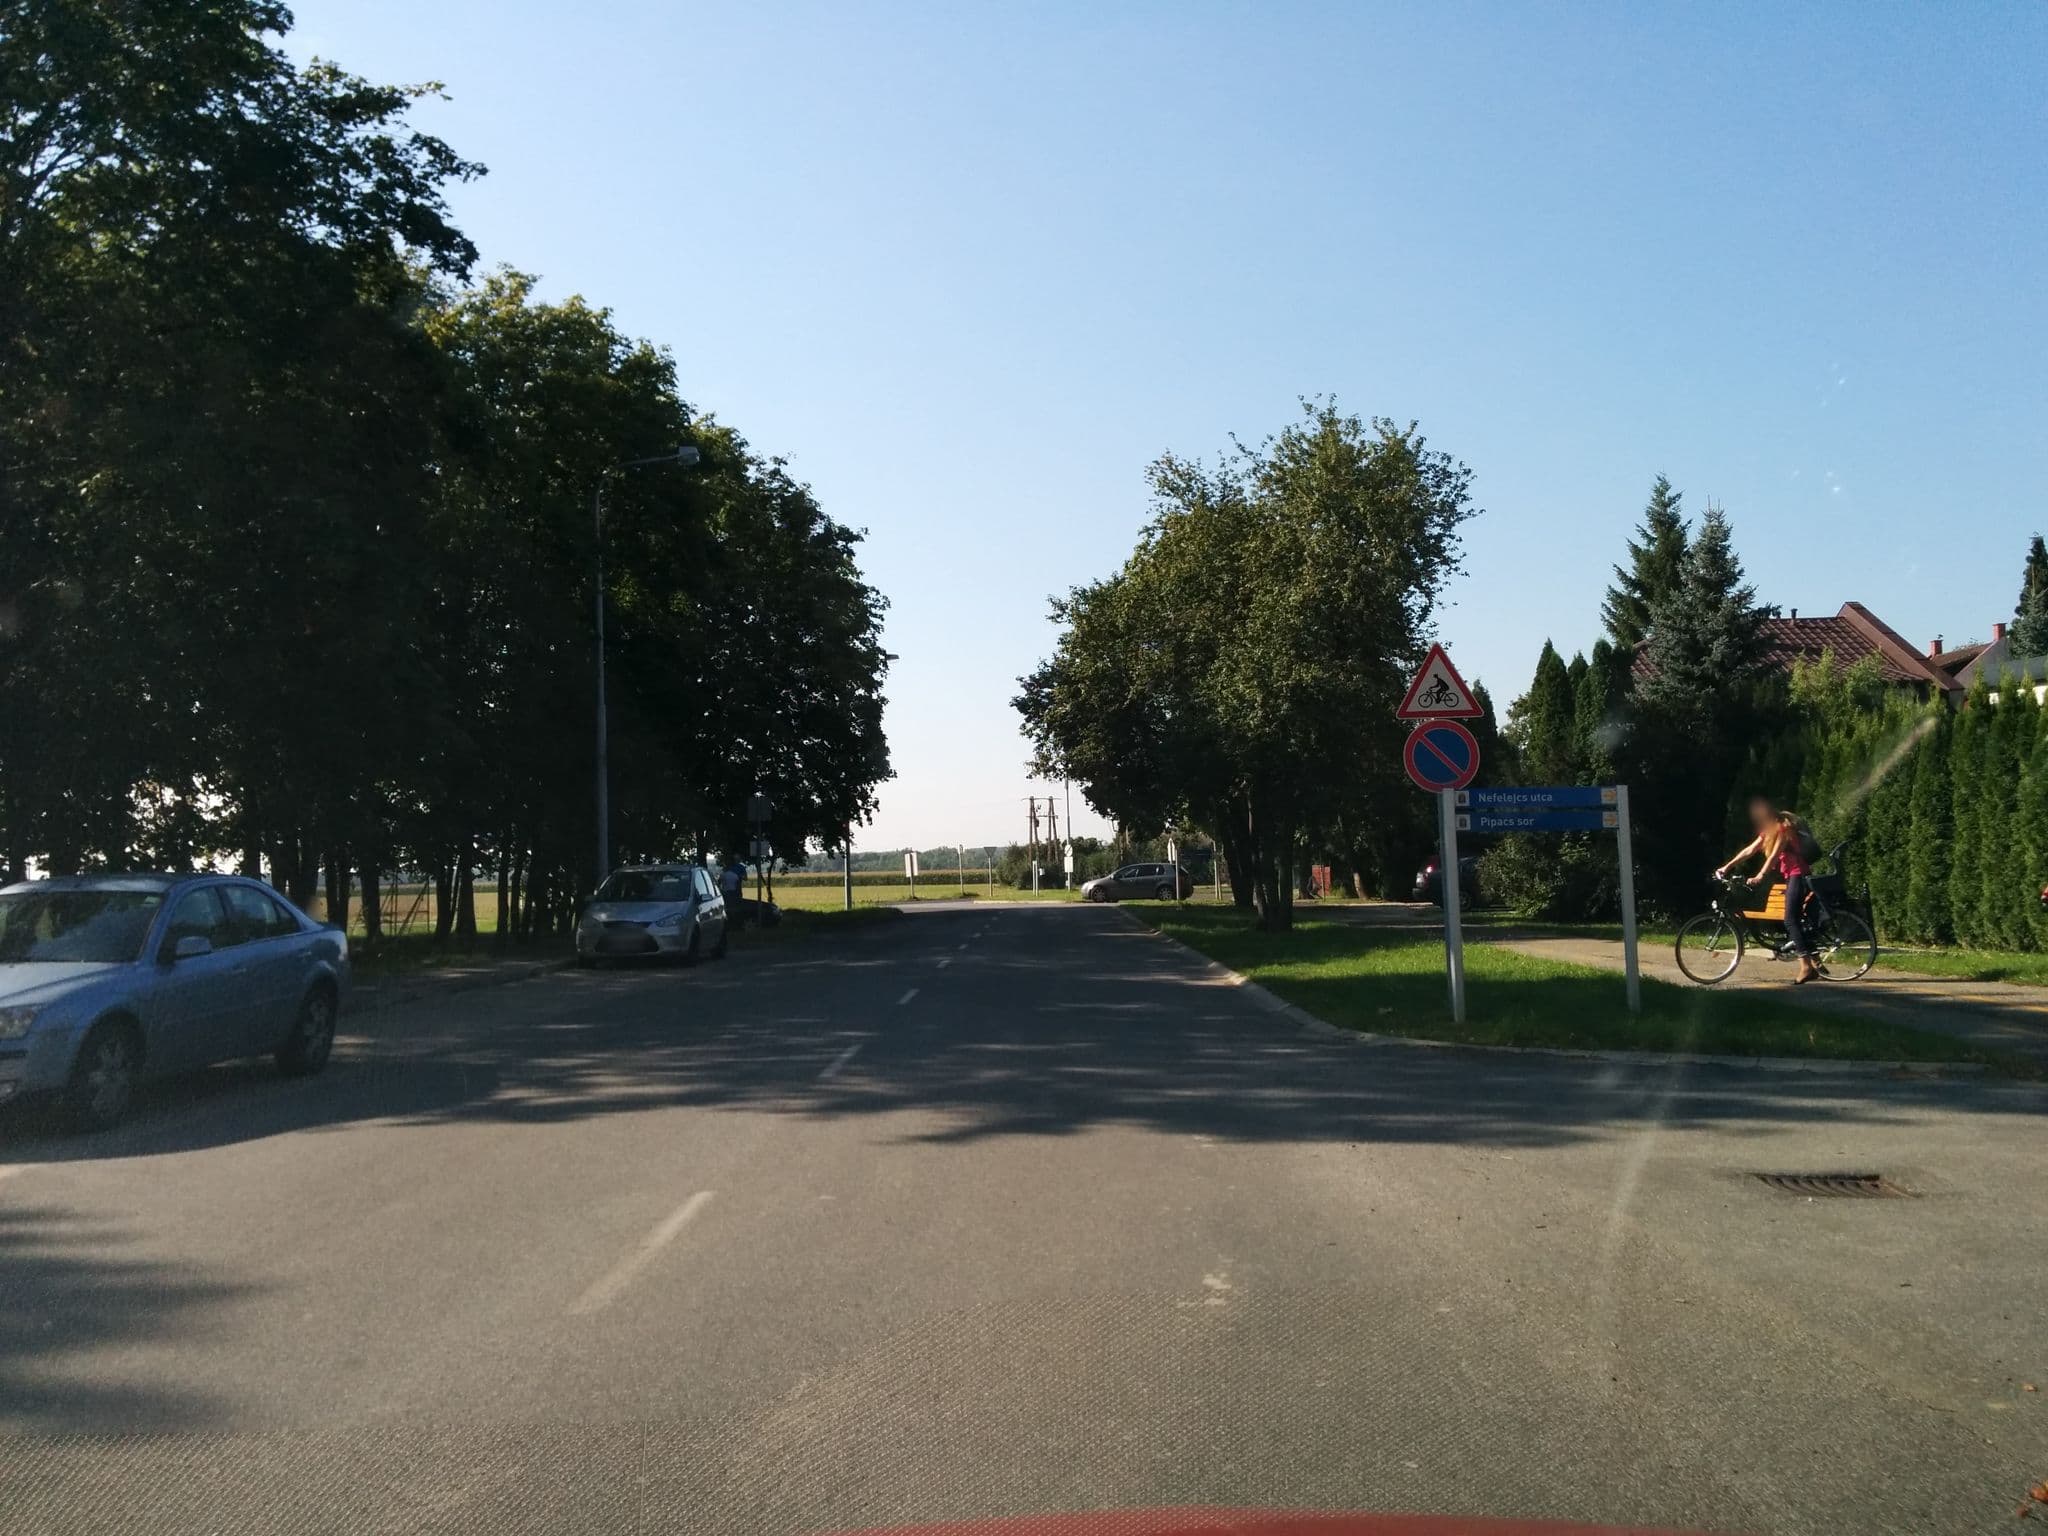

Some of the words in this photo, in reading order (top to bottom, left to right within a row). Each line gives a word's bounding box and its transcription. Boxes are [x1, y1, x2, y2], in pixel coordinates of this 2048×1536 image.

[1478, 792, 1528, 803] Nefelejcs
[1530, 793, 1553, 802] utca
[1480, 816, 1515, 828] Pipacs
[1517, 818, 1534, 826] sor
